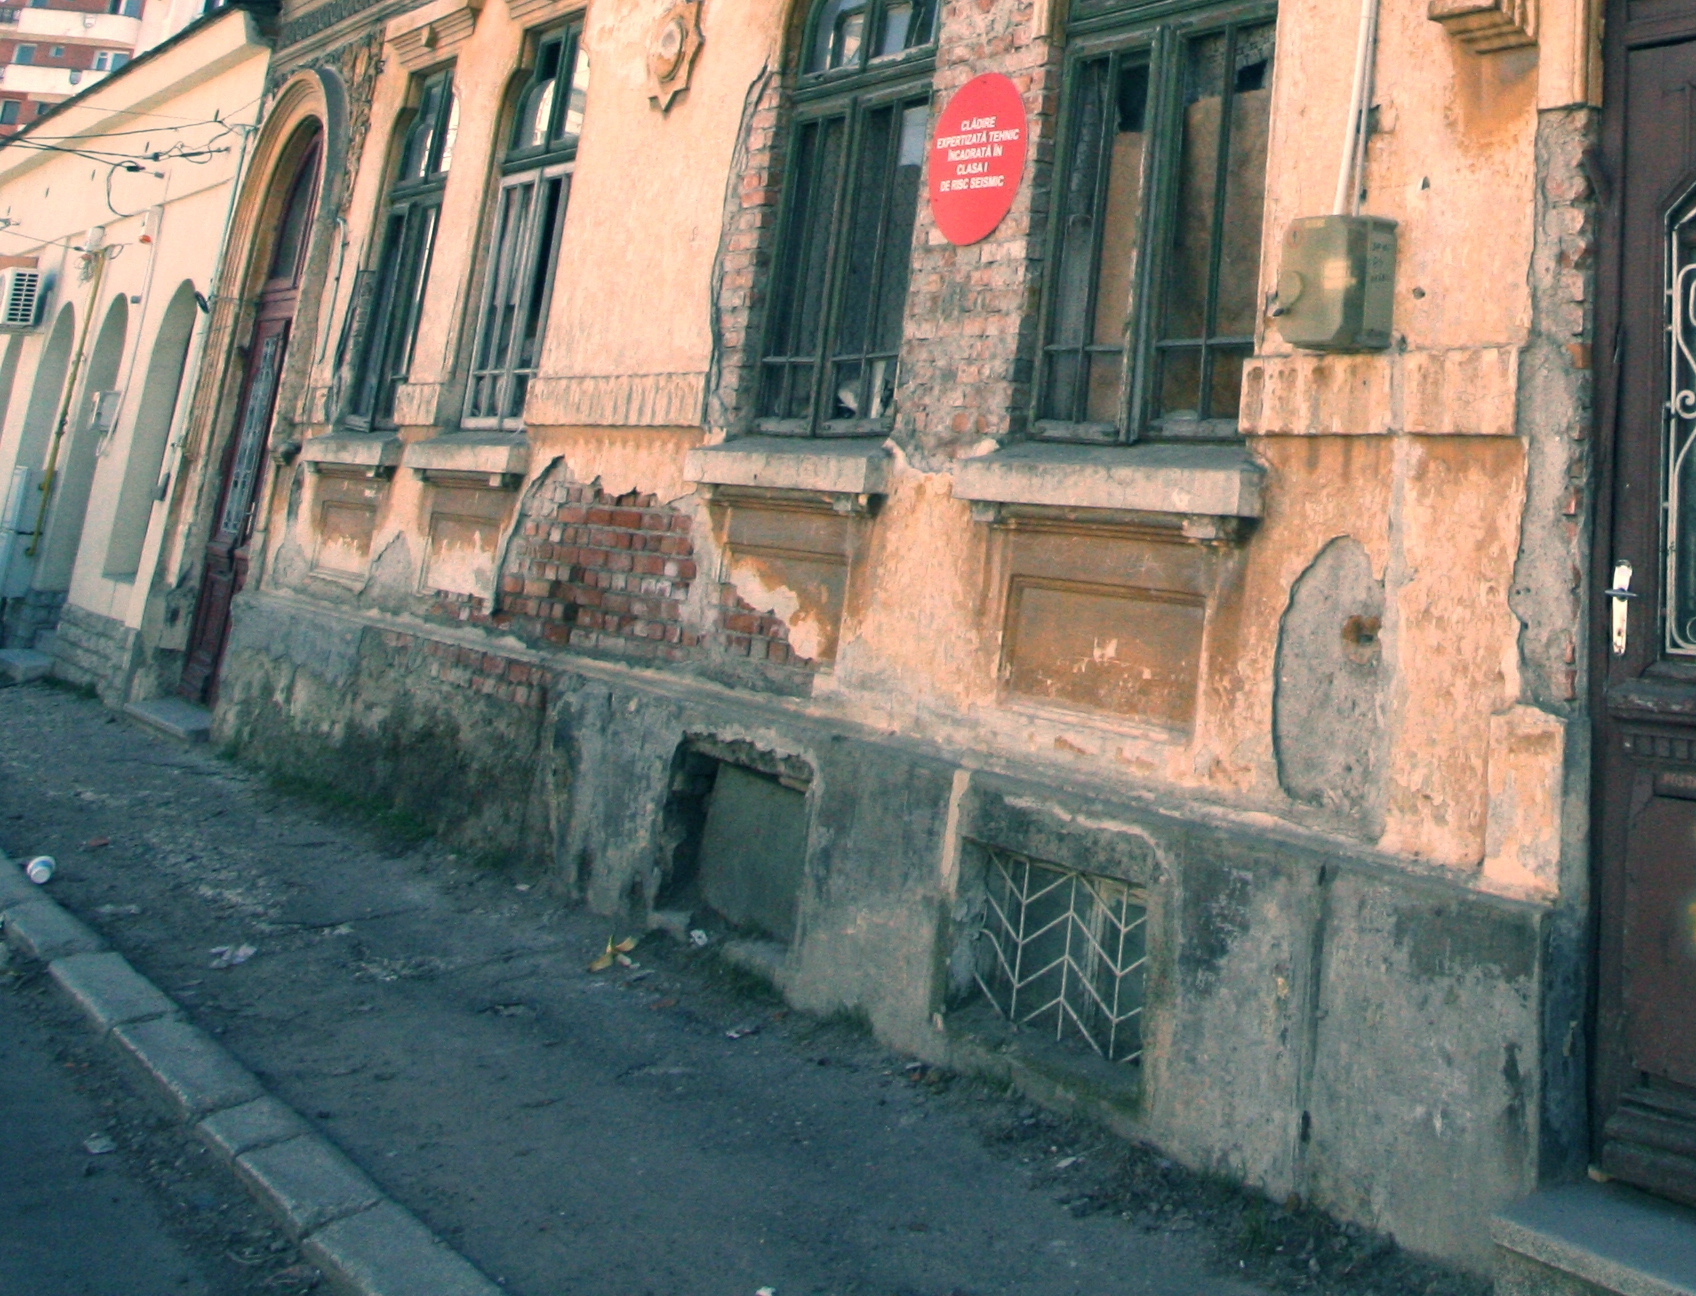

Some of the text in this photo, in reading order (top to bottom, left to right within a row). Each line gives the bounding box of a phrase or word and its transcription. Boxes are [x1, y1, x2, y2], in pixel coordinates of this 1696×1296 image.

[961, 116, 996, 131] CLĂDIRE
[937, 129, 1020, 149] EXPERTIZATĂ TEHNIC
[947, 144, 1003, 161] ÎNCADRATĂ ÎN
[957, 162, 983, 175] CLASA
[940, 175, 1004, 193] DE RISC SEISMIC
